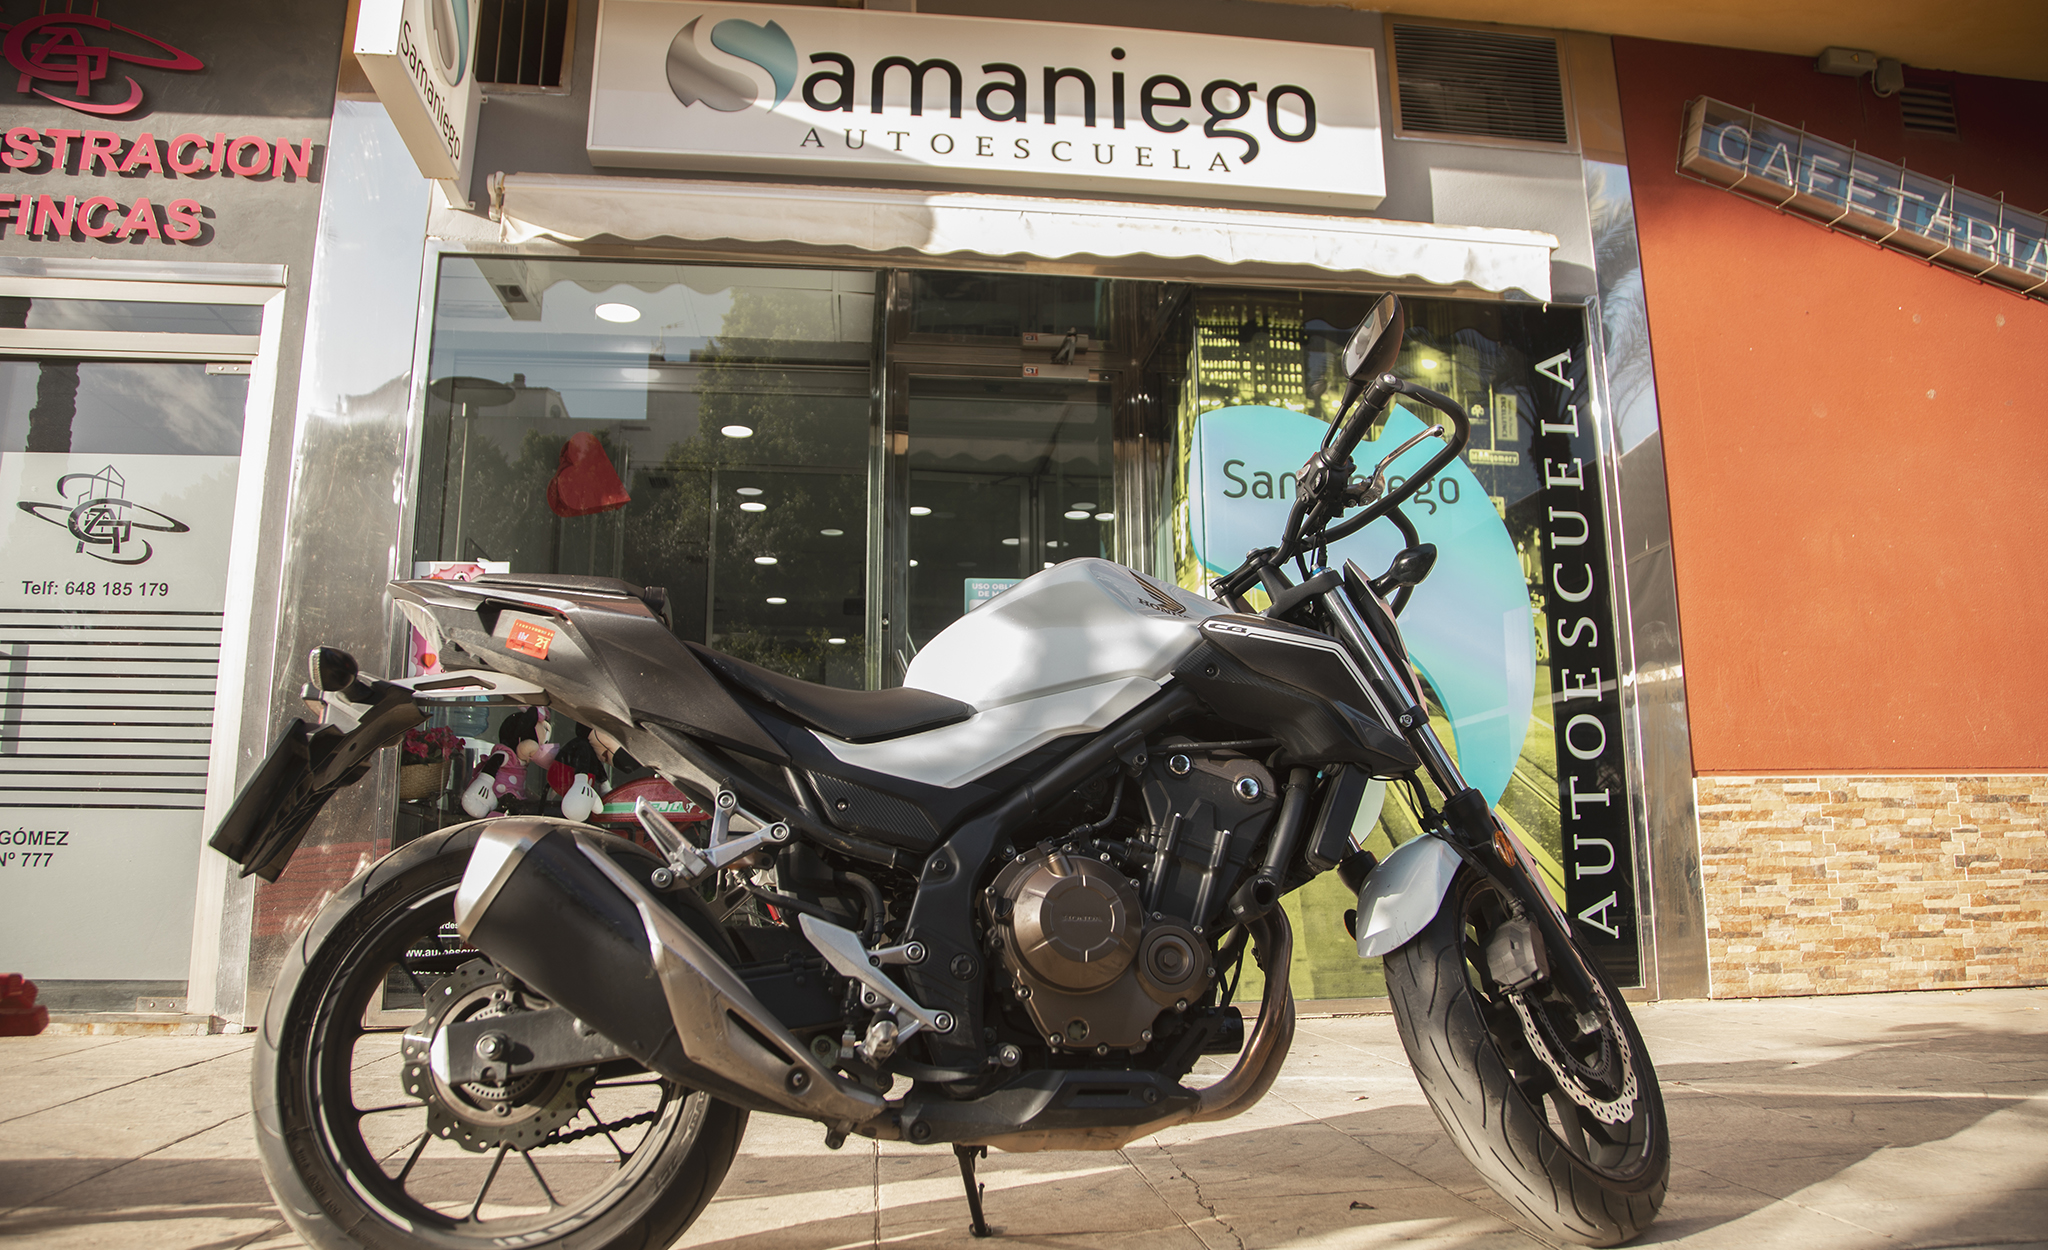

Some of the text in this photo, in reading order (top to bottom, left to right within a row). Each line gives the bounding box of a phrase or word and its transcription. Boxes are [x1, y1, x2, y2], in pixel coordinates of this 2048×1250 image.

[401, 20, 461, 160] Samaniego
[800, 127, 1231, 173] AUTOESCUELA
[1223, 459, 1460, 515] Saego
[22, 581, 169, 597] Telf: 648 185 179
[1534, 348, 1620, 939] AUTOESCUELA
[0, 827, 69, 846] GÓMEZ
[21, 853, 54, 868] 777
